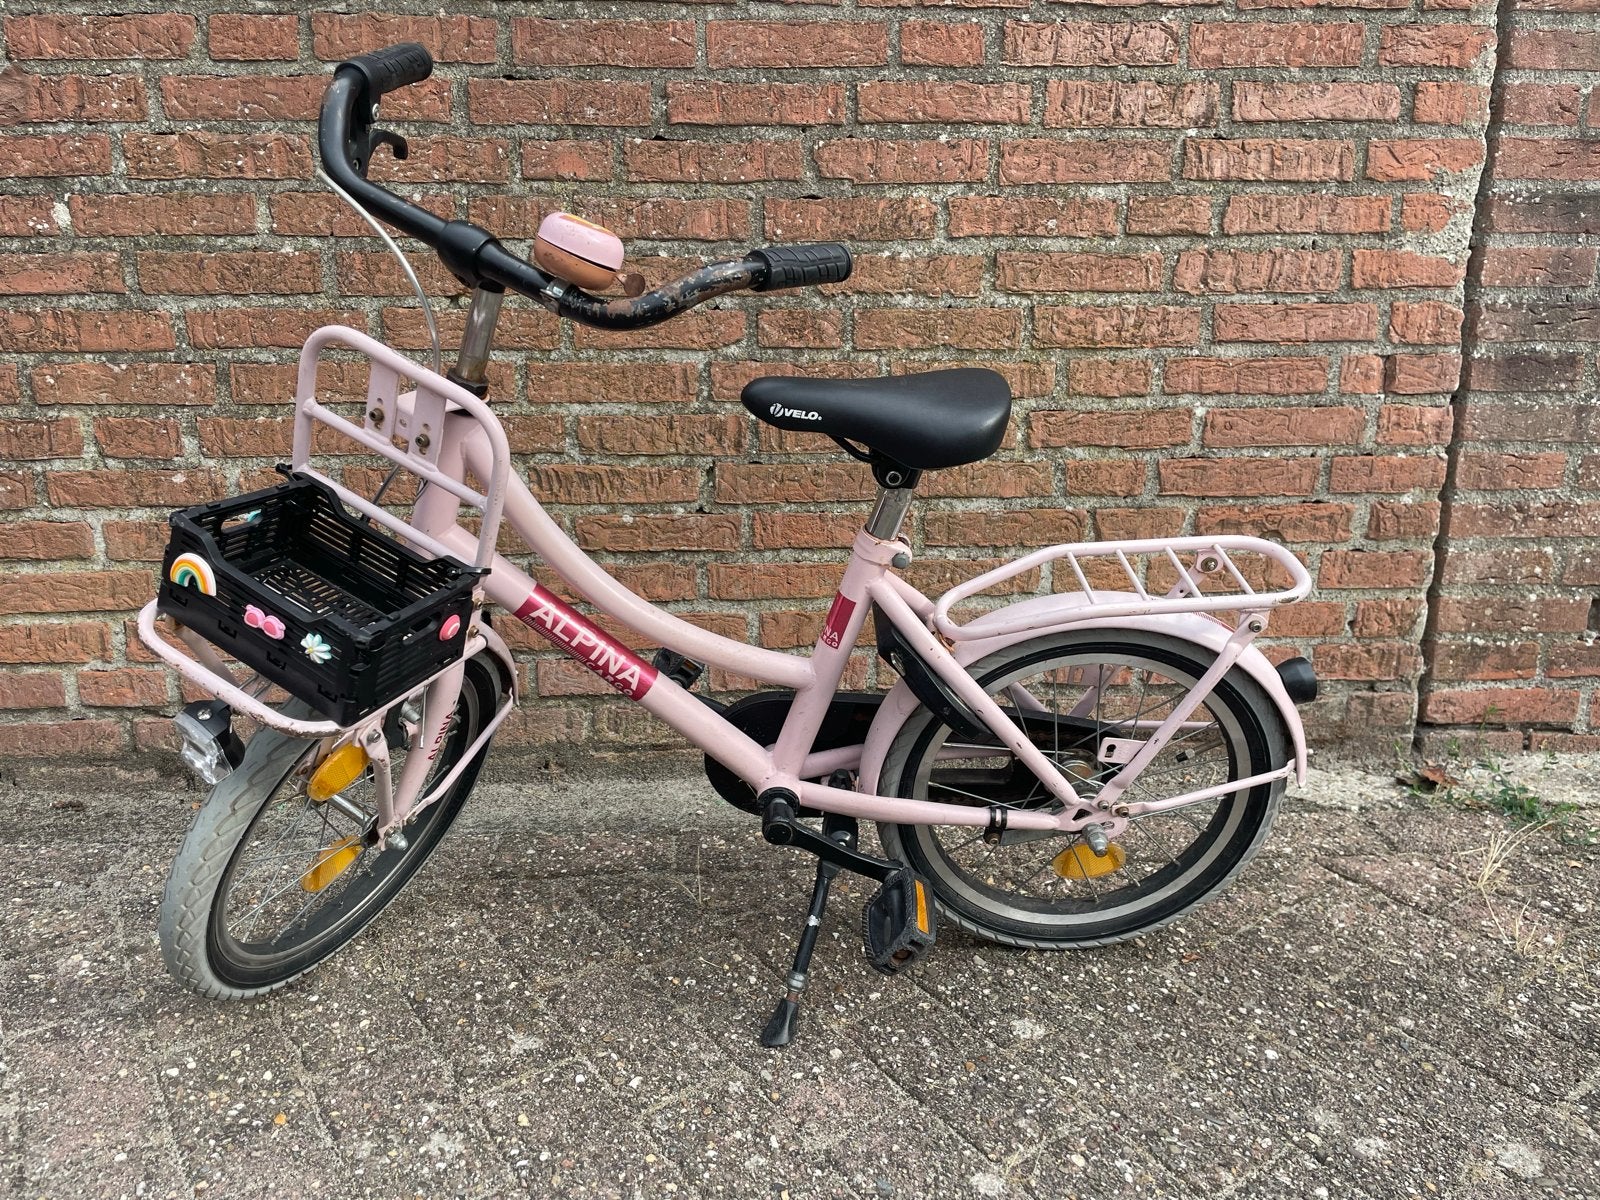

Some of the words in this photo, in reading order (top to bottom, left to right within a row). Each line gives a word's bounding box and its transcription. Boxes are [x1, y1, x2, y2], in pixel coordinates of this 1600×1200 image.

[784, 408, 820, 421] VELO
[529, 602, 642, 691] ALPINA
[586, 661, 634, 696] CARGO
